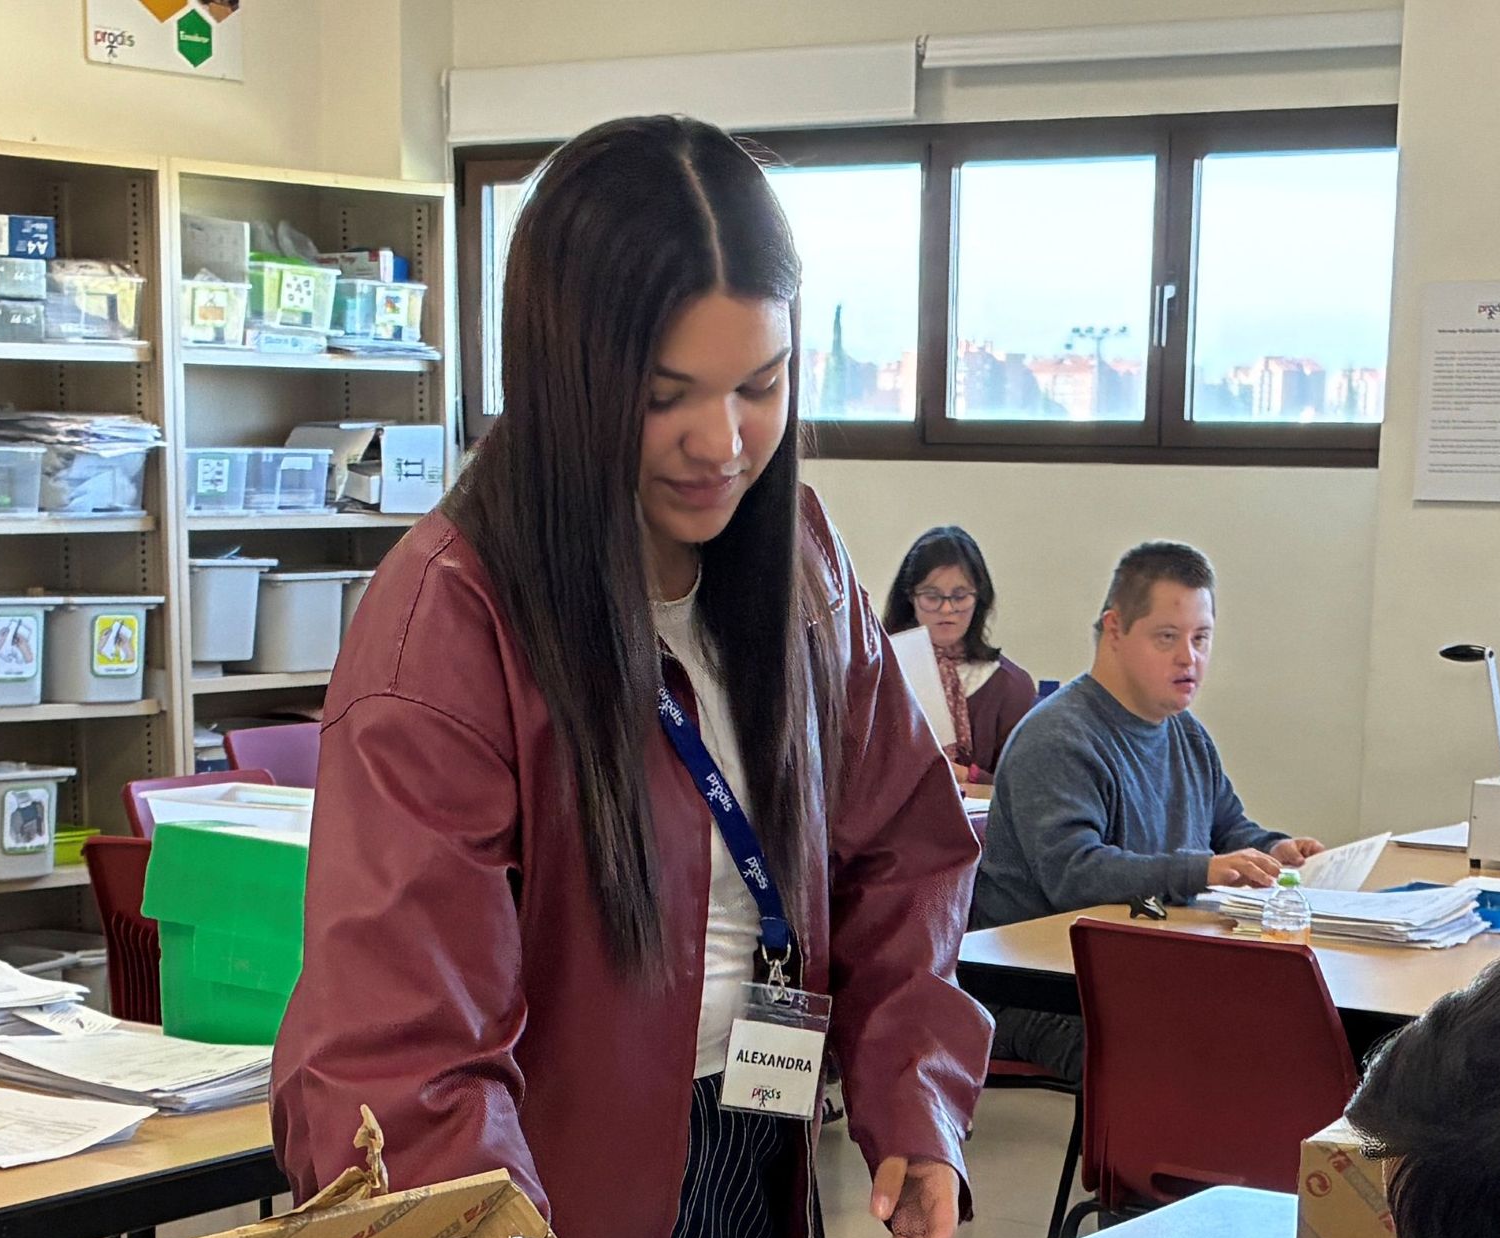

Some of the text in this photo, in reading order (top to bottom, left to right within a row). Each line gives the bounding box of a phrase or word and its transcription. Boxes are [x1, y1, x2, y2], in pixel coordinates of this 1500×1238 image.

[27, 240, 49, 255] A4
[705, 772, 733, 813] prodis
[745, 856, 769, 891] prodis
[736, 1048, 812, 1073] ALEXANDRA
